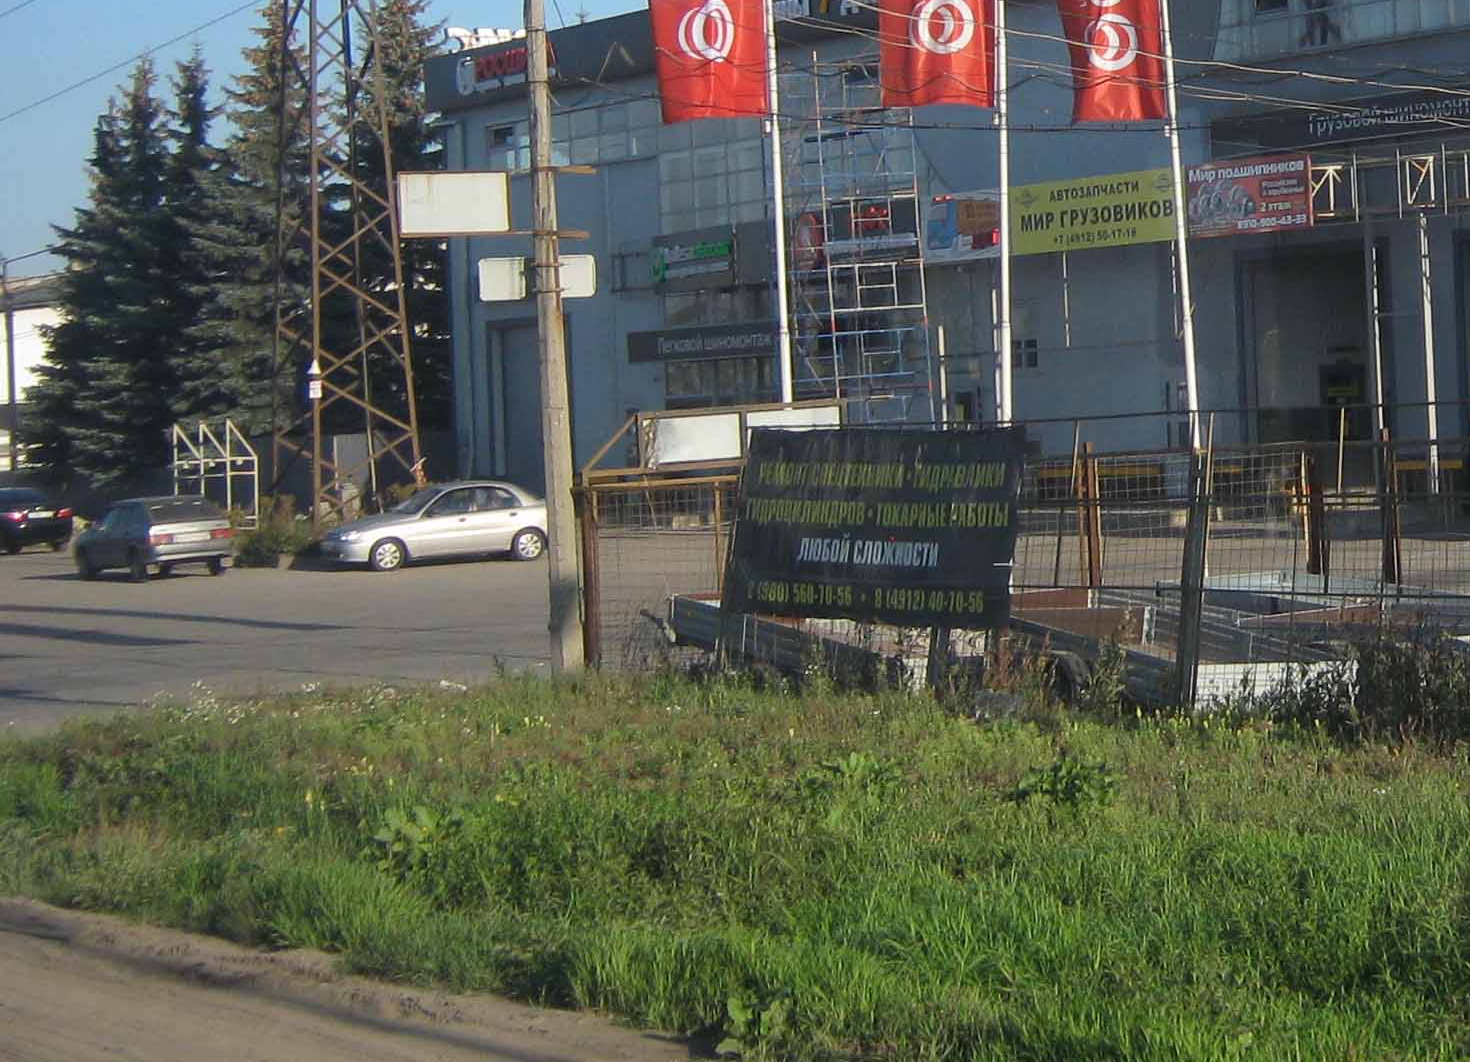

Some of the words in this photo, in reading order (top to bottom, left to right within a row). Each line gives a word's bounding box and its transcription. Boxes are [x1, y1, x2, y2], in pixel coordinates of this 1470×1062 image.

[1188, 169, 1216, 184] Мир
[1218, 160, 1305, 179] подшипников
[1049, 180, 1140, 203] АВТОЗАПЧАСТИ
[1020, 212, 1055, 233] МИР
[1060, 199, 1174, 229] ГРУЗОВИКОВ
[949, 502, 1009, 528] РАБОТЫ
[797, 532, 850, 564] ЛЮБОЙ
[852, 539, 940, 568] СЛОЖНОСТИ
